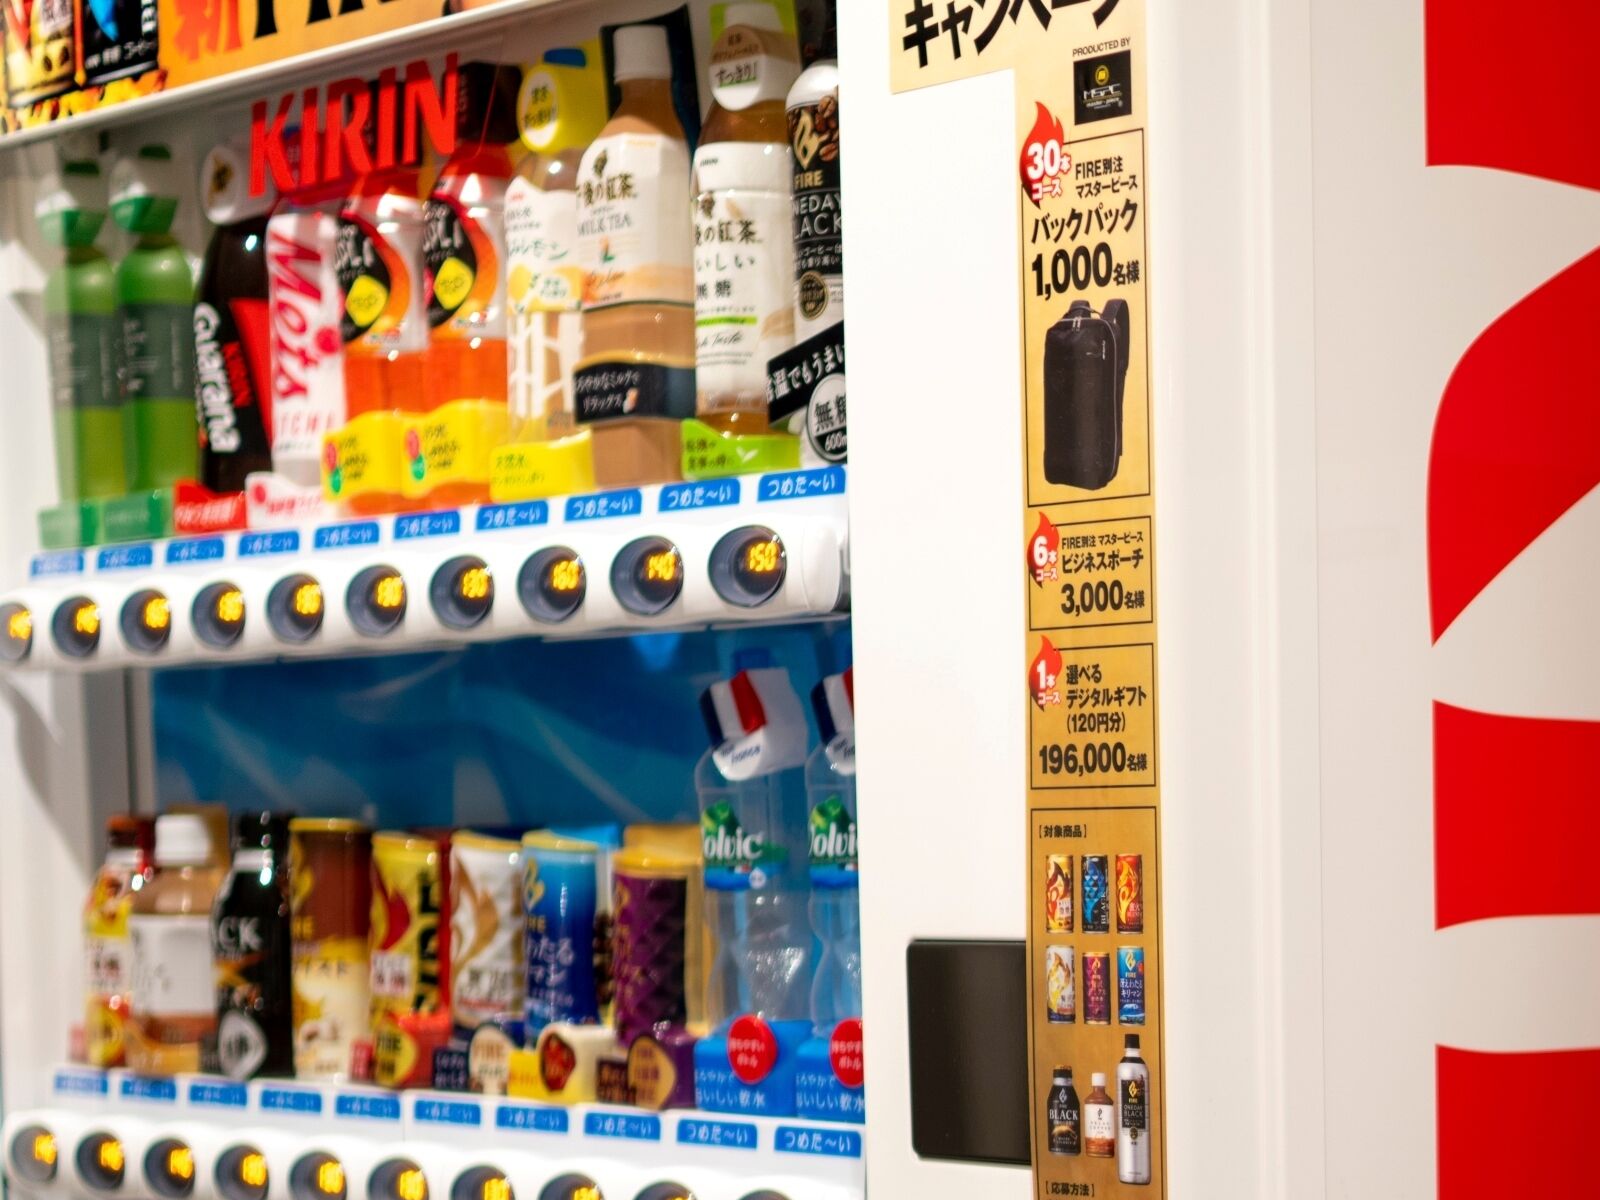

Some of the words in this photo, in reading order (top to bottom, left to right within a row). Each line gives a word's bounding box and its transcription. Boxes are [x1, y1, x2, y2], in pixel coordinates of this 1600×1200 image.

[1072, 41, 1119, 57] PRODUCTED
[1120, 37, 1131, 48] BY
[249, 50, 460, 198] KIRIN
[1074, 155, 1124, 181] FIRE別注
[1031, 177, 1063, 201] コース
[1074, 174, 1139, 199] マスターピース
[1031, 198, 1139, 244] バックパック
[193, 301, 242, 453] Guarana
[646, 550, 677, 581] 140
[746, 541, 777, 573] 150
[1061, 547, 1145, 574] ビジネスポーチ
[1035, 568, 1058, 582] コース
[1065, 663, 1102, 686] 選べる
[1037, 691, 1061, 706] コース
[1065, 685, 1147, 710] デジタルギフト
[1066, 711, 1127, 734] (120円分)
[704, 823, 764, 861] olvic
[1049, 1109, 1078, 1121] BLACK
